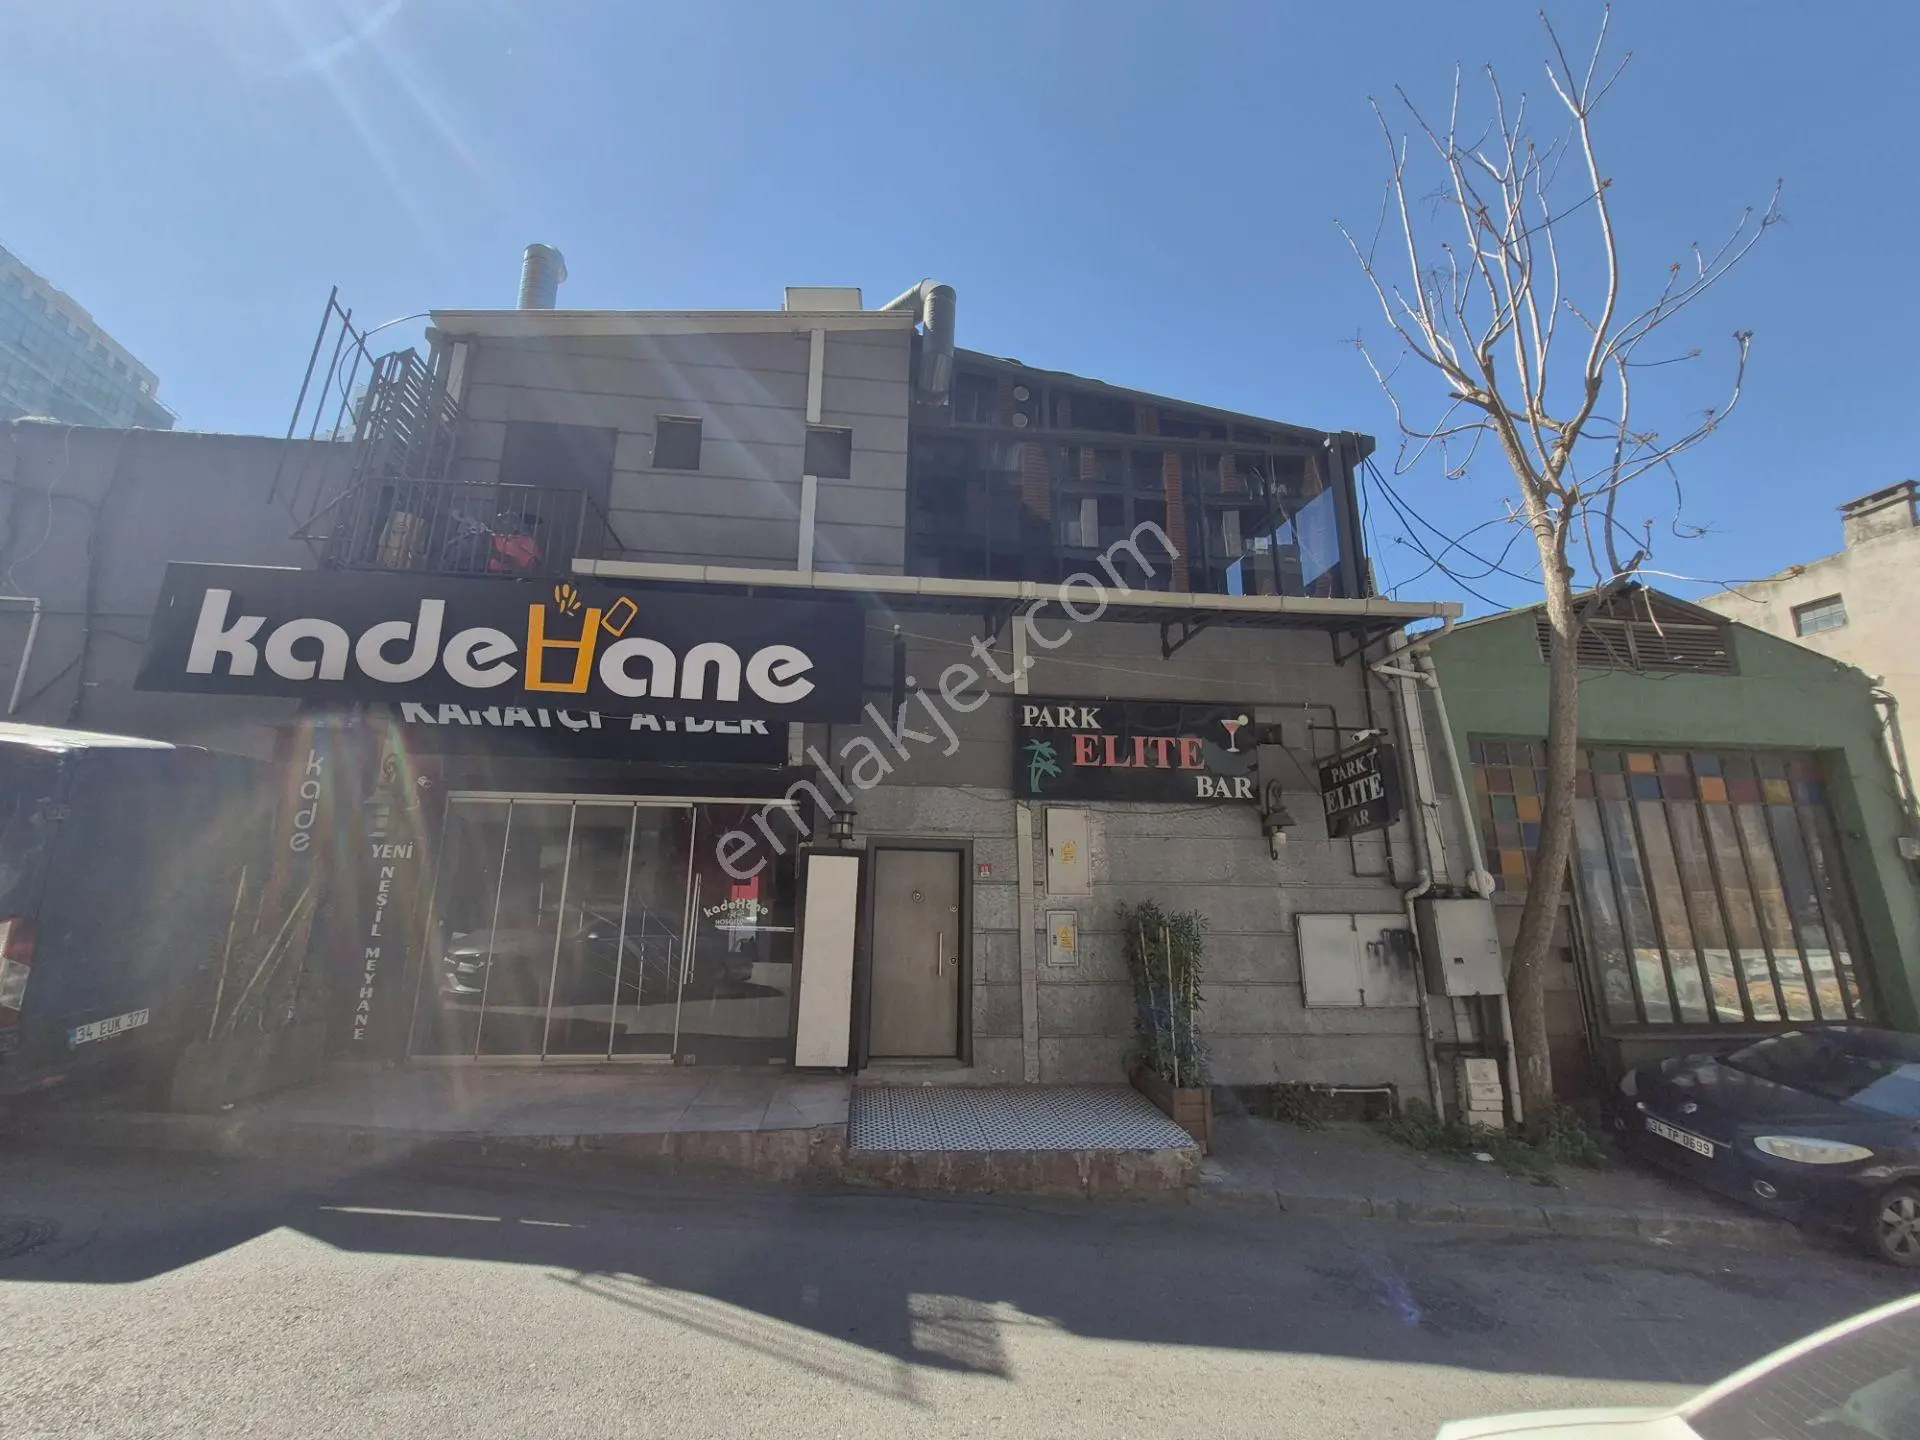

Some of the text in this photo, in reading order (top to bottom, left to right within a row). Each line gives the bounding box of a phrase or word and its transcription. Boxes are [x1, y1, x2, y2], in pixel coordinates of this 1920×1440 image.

[1022, 705, 1102, 729] PARK
[1072, 733, 1205, 770] ELITE
[1331, 755, 1367, 783] PARK
[1195, 775, 1256, 799] BAR
[1323, 772, 1385, 816] ELITE
[353, 947, 380, 1040] MEYHANE
[78, 1025, 93, 1041] 34
[1650, 1120, 1664, 1134] 34
